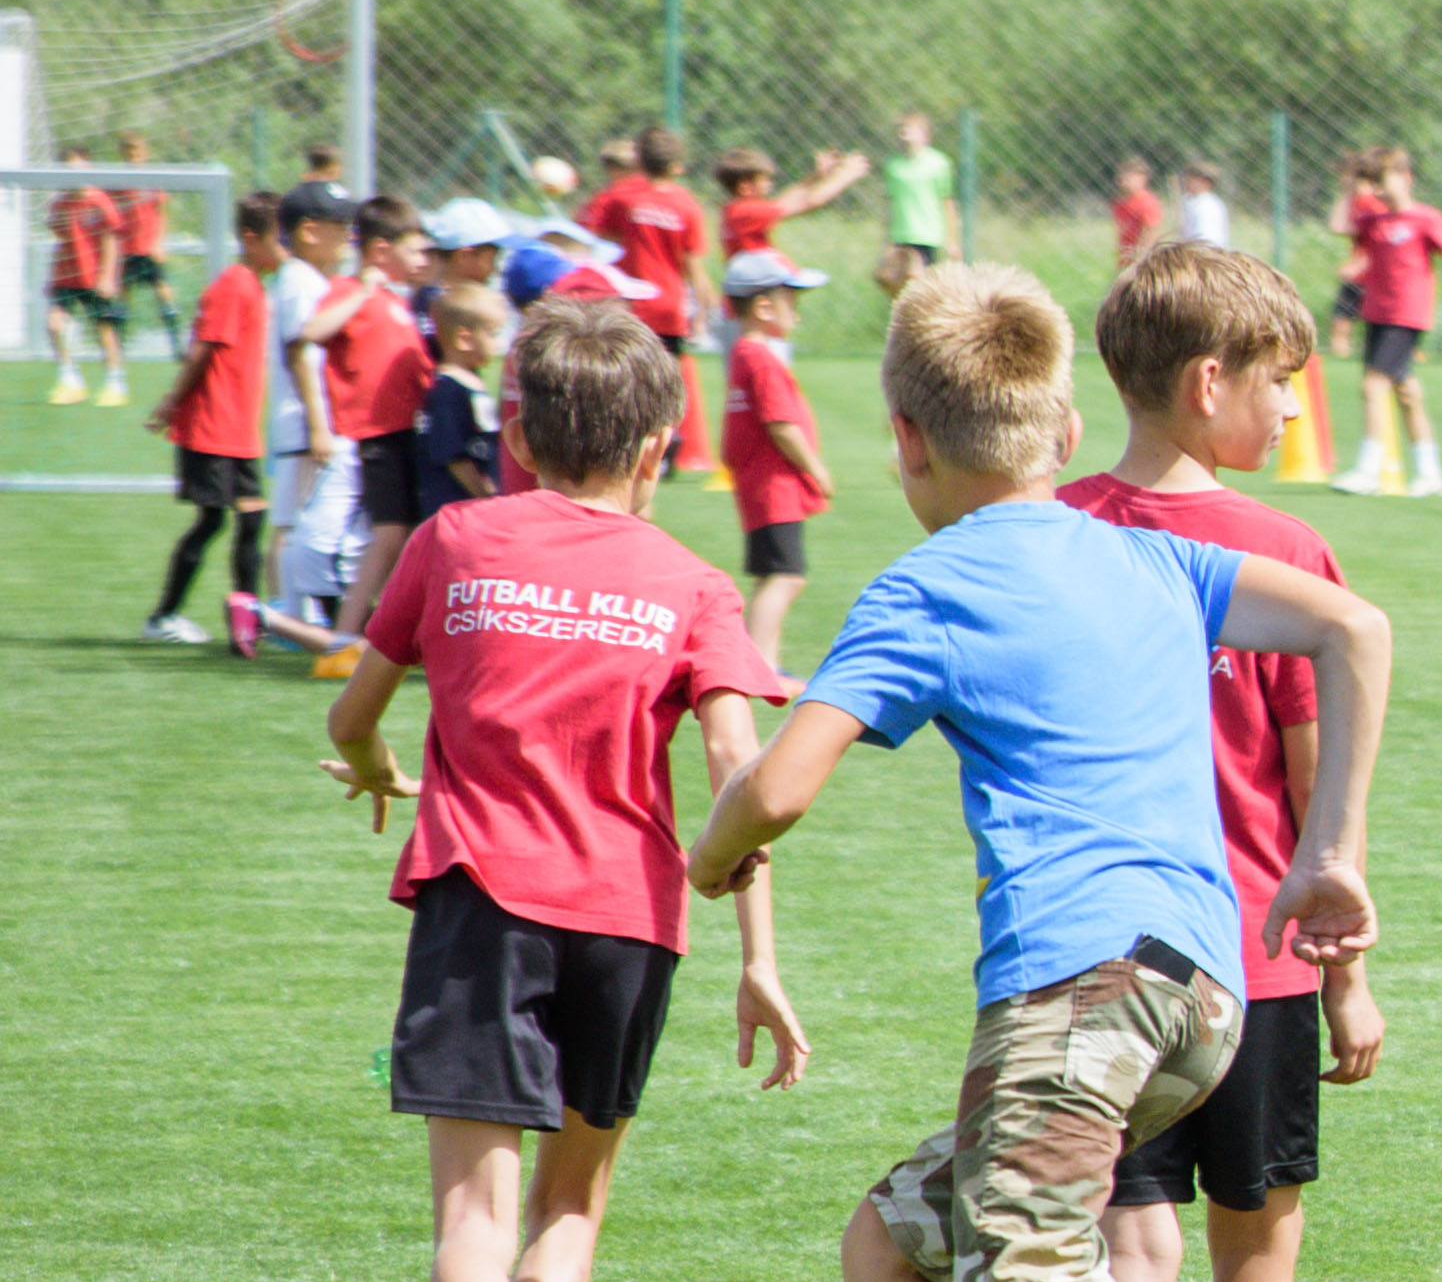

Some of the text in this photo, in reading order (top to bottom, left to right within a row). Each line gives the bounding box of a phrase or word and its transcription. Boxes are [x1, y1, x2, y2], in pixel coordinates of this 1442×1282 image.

[443, 606, 666, 656] CSÍKSZEREDA
[447, 578, 677, 633] FUTBALL KLUB
